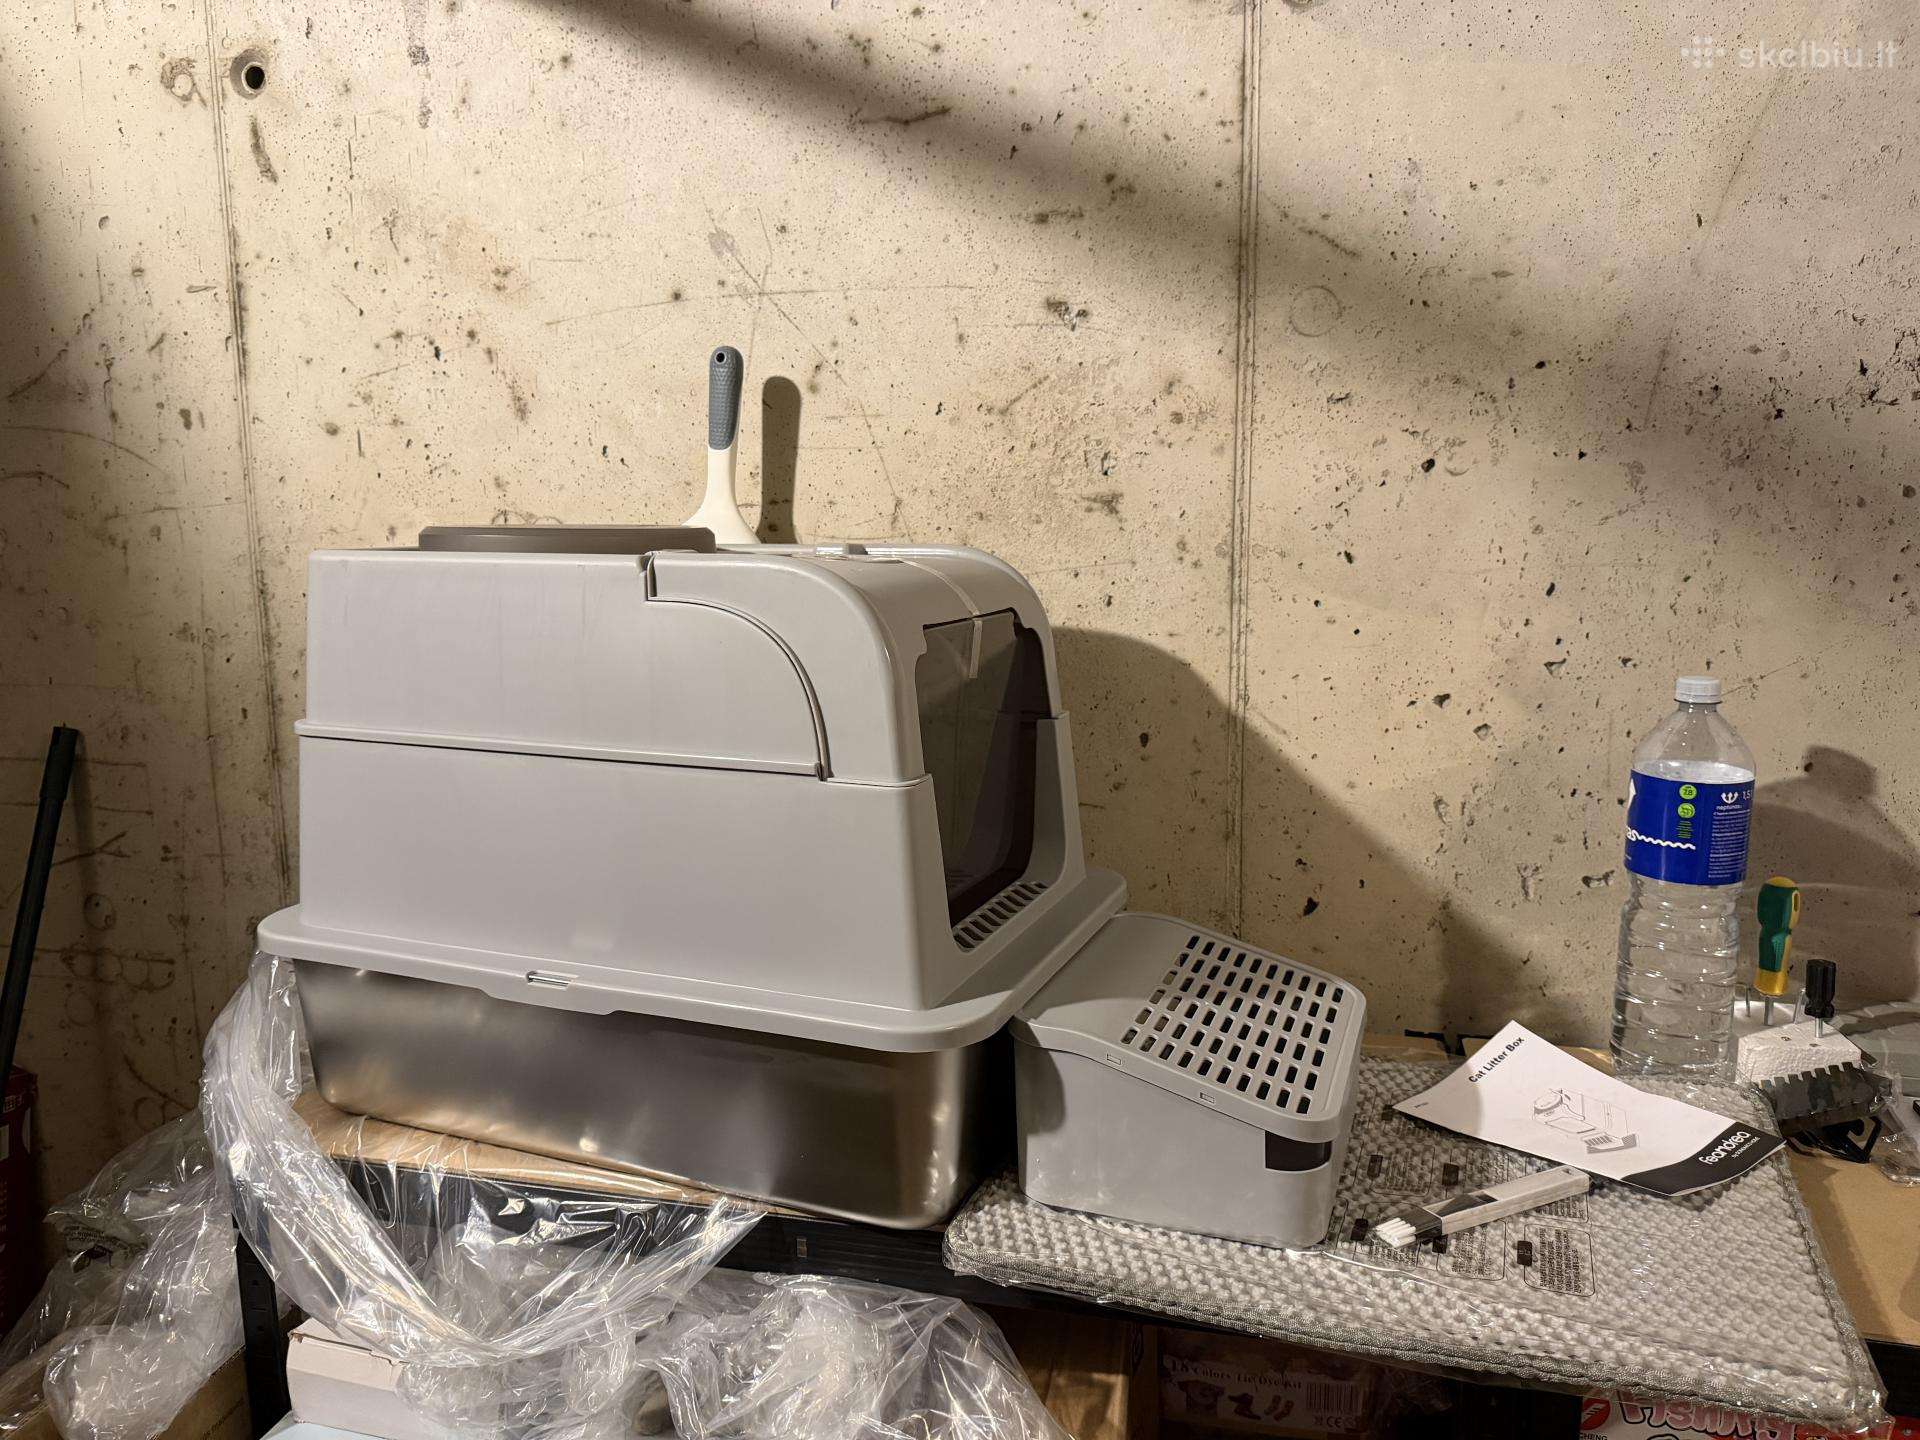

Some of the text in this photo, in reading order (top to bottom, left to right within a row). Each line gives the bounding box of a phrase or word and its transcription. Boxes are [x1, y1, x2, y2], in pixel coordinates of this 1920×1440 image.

[1468, 1036, 1525, 1083] Cat Litter Box
[1698, 1131, 1752, 1165] feandrea
